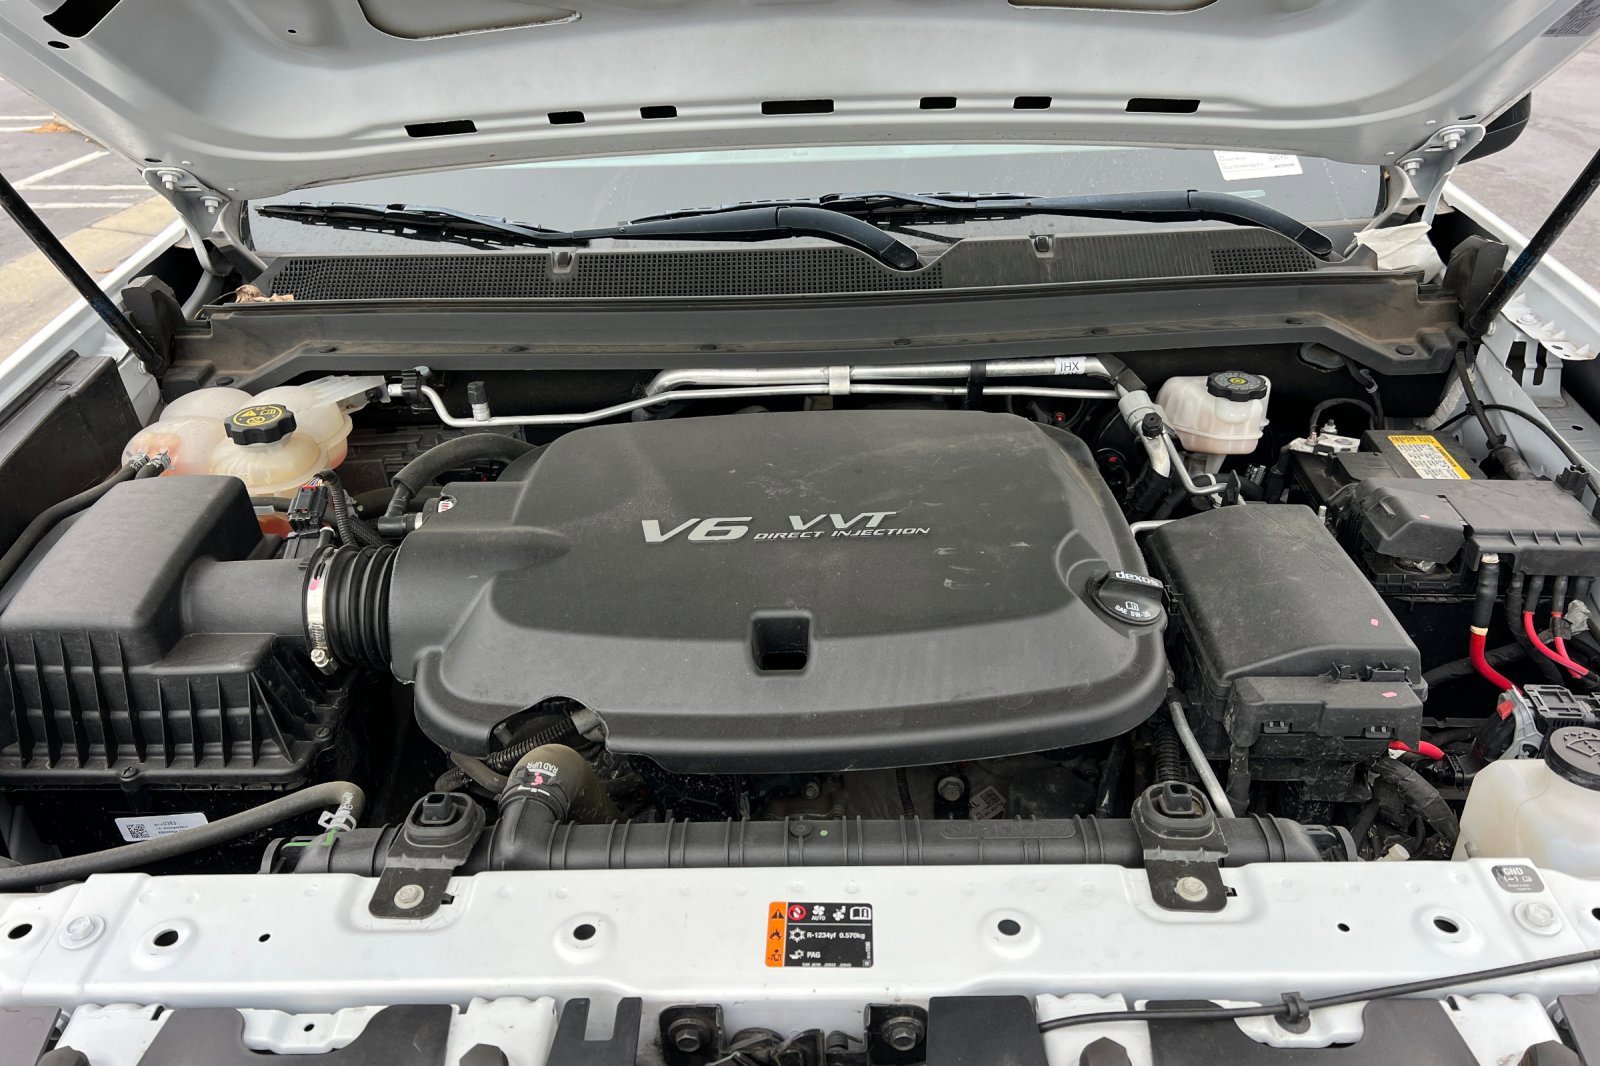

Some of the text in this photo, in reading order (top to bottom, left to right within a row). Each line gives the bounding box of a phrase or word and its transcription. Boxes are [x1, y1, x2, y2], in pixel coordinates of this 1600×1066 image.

[789, 511, 898, 530] VVT
[641, 516, 753, 543] V6
[753, 527, 931, 540] DIRECT INJECTION
[1115, 570, 1159, 587] dexos
[1114, 604, 1129, 615] SAE
[526, 761, 559, 774] RAD UPR
[1502, 867, 1524, 876] GND
[806, 931, 866, 940] R-1234yf 0.570kg
[806, 951, 821, 959] PAG
